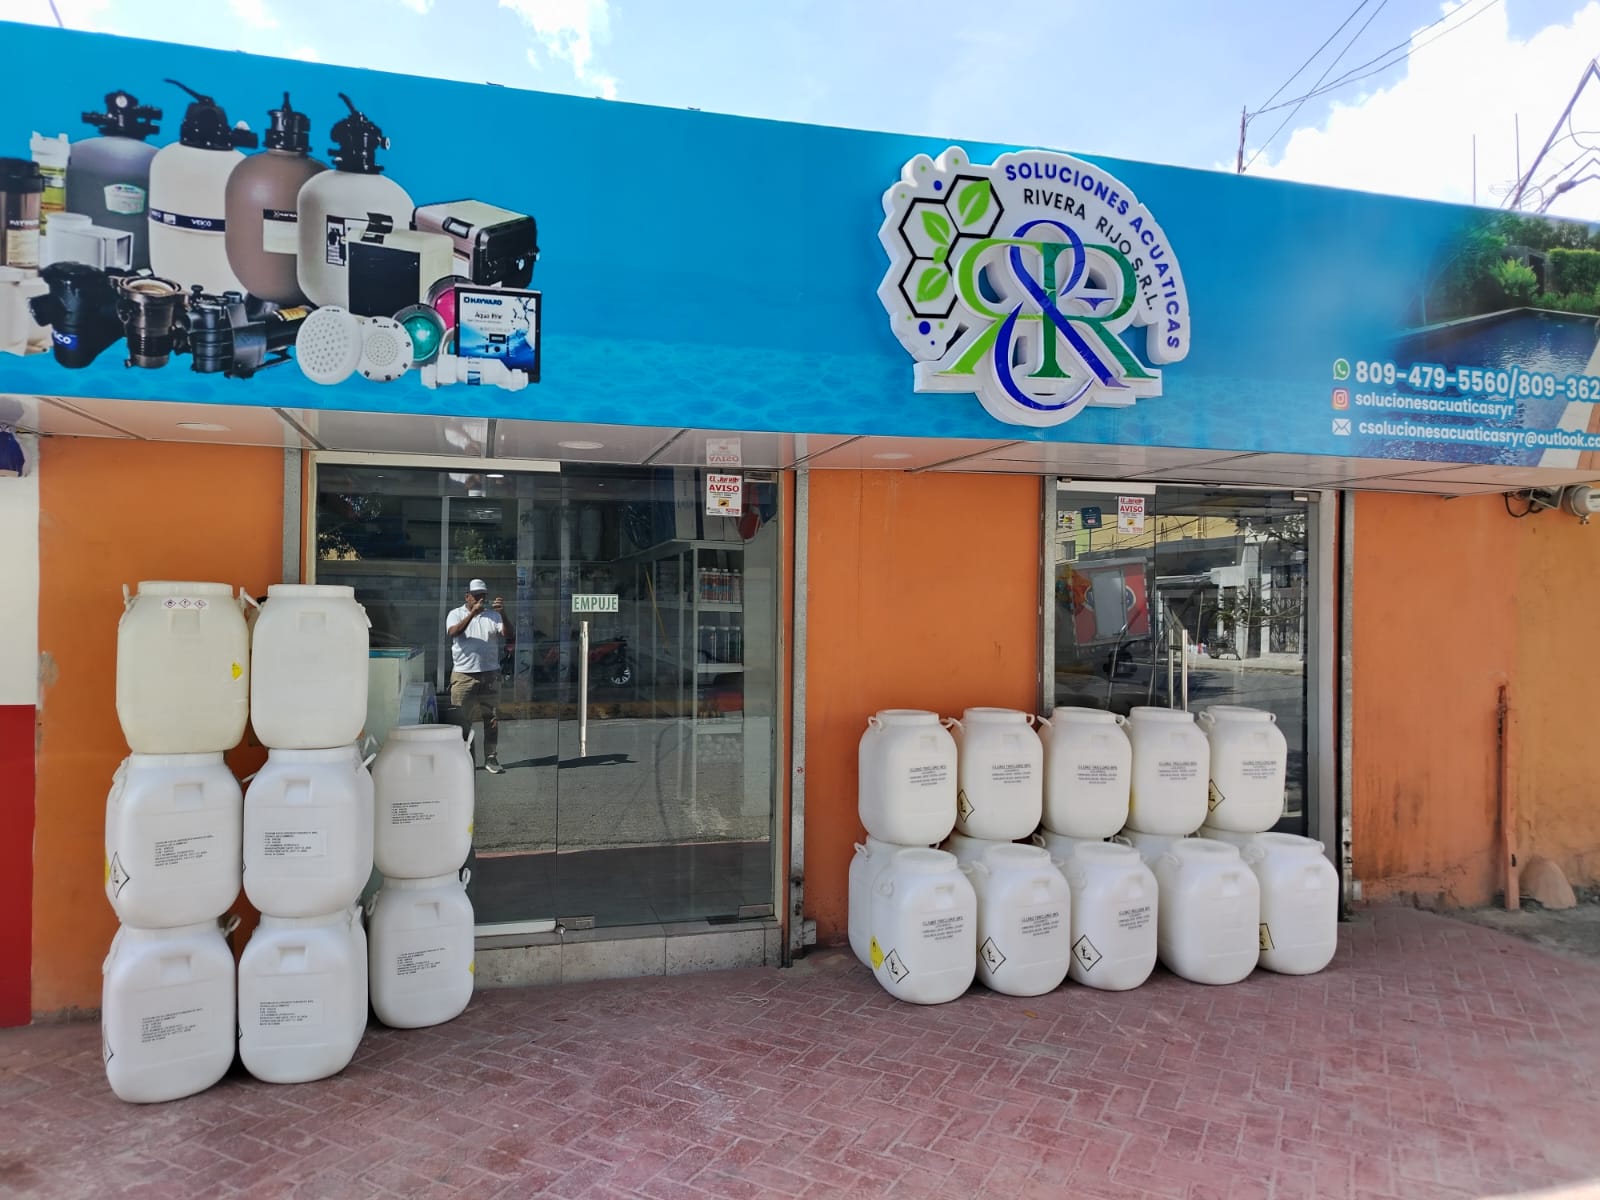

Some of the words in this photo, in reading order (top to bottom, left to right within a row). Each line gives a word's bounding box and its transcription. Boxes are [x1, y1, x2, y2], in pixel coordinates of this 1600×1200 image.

[1023, 188, 1086, 221] RIVERA
[1095, 216, 1132, 256] RIJO
[1005, 162, 1129, 216] SOLUCIONES
[1129, 216, 1180, 349] ACUATICAS
[1355, 360, 1600, 400] 809-479-5560/809-362
[1355, 391, 1514, 420] solucionesacuaticasryr
[709, 484, 740, 492] AVISO
[1120, 505, 1143, 513] AVISO
[574, 596, 617, 610] EMPUJE
